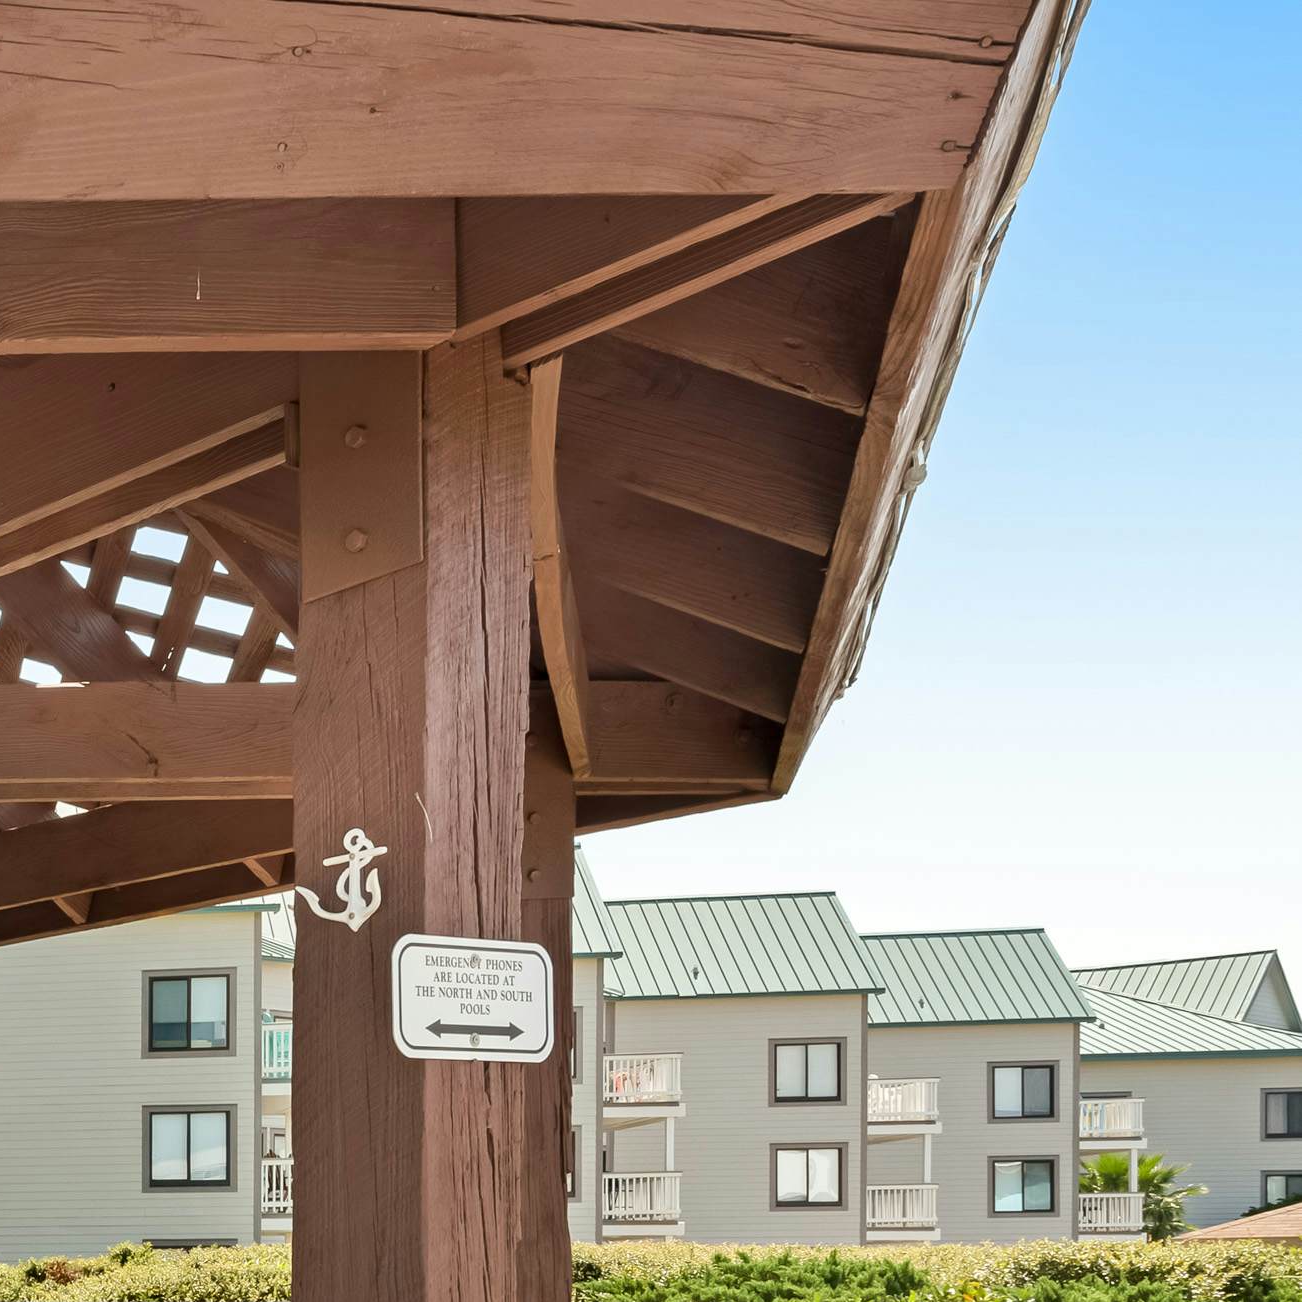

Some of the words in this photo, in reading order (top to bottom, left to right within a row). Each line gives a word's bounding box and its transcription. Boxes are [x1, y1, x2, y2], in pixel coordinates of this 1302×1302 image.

[486, 960, 523, 972] PHONES
[433, 972, 452, 982] ARE
[456, 973, 499, 985] LOCATED
[503, 976, 515, 986] AT
[415, 986, 435, 997] THE
[439, 987, 472, 999] NORTH
[477, 989, 497, 1000] AND
[501, 990, 532, 1002] SOUTH
[460, 1004, 490, 1015] POOLS
